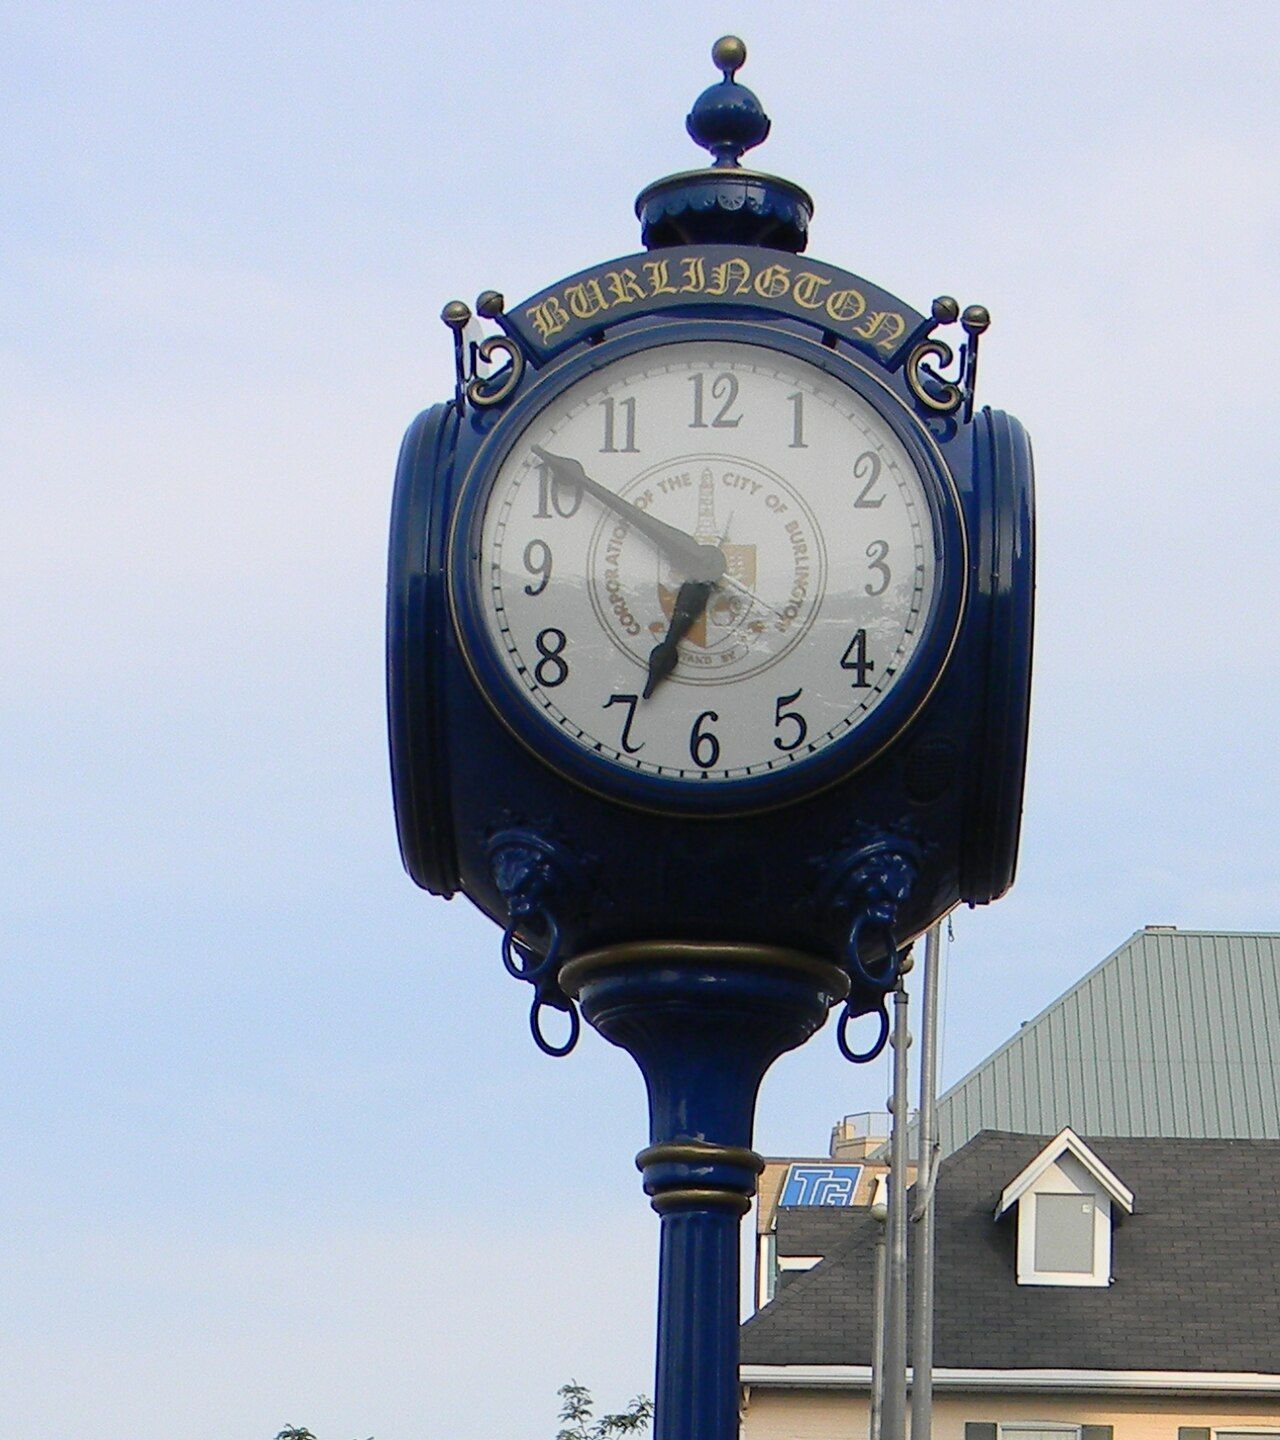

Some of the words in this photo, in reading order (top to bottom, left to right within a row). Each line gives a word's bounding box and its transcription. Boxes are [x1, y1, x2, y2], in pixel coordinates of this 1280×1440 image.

[526, 256, 911, 349] BURLINGTON
[598, 396, 641, 453] 11
[687, 371, 744, 430] 12
[786, 391, 810, 449] 1
[531, 458, 584, 519] 10
[657, 471, 693, 495] THE
[722, 472, 763, 496] CITY
[765, 494, 789, 515] OF
[852, 450, 889, 509] 2
[522, 539, 553, 597] 9
[864, 539, 892, 597] 3
[533, 627, 570, 688] 8
[676, 650, 713, 665] TAND
[839, 627, 875, 689] 4
[602, 693, 647, 753] 7
[689, 710, 720, 769] 6
[772, 686, 808, 752] 5
